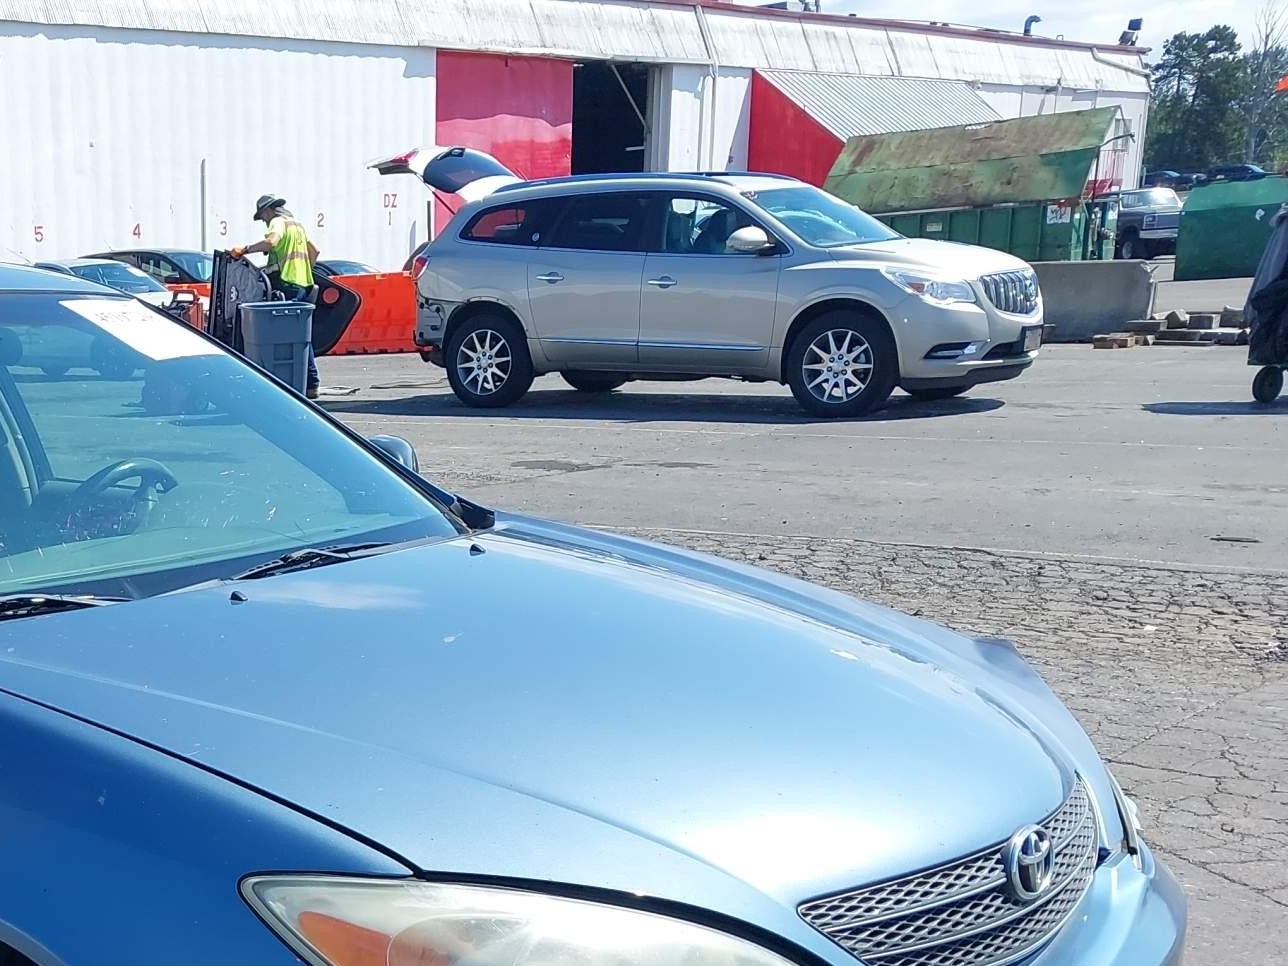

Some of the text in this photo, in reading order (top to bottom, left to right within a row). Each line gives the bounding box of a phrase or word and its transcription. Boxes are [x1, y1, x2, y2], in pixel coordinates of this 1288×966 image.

[316, 213, 325, 228] 2
[34, 226, 44, 242] 5
[132, 223, 142, 239] 4
[219, 221, 228, 236] 3
